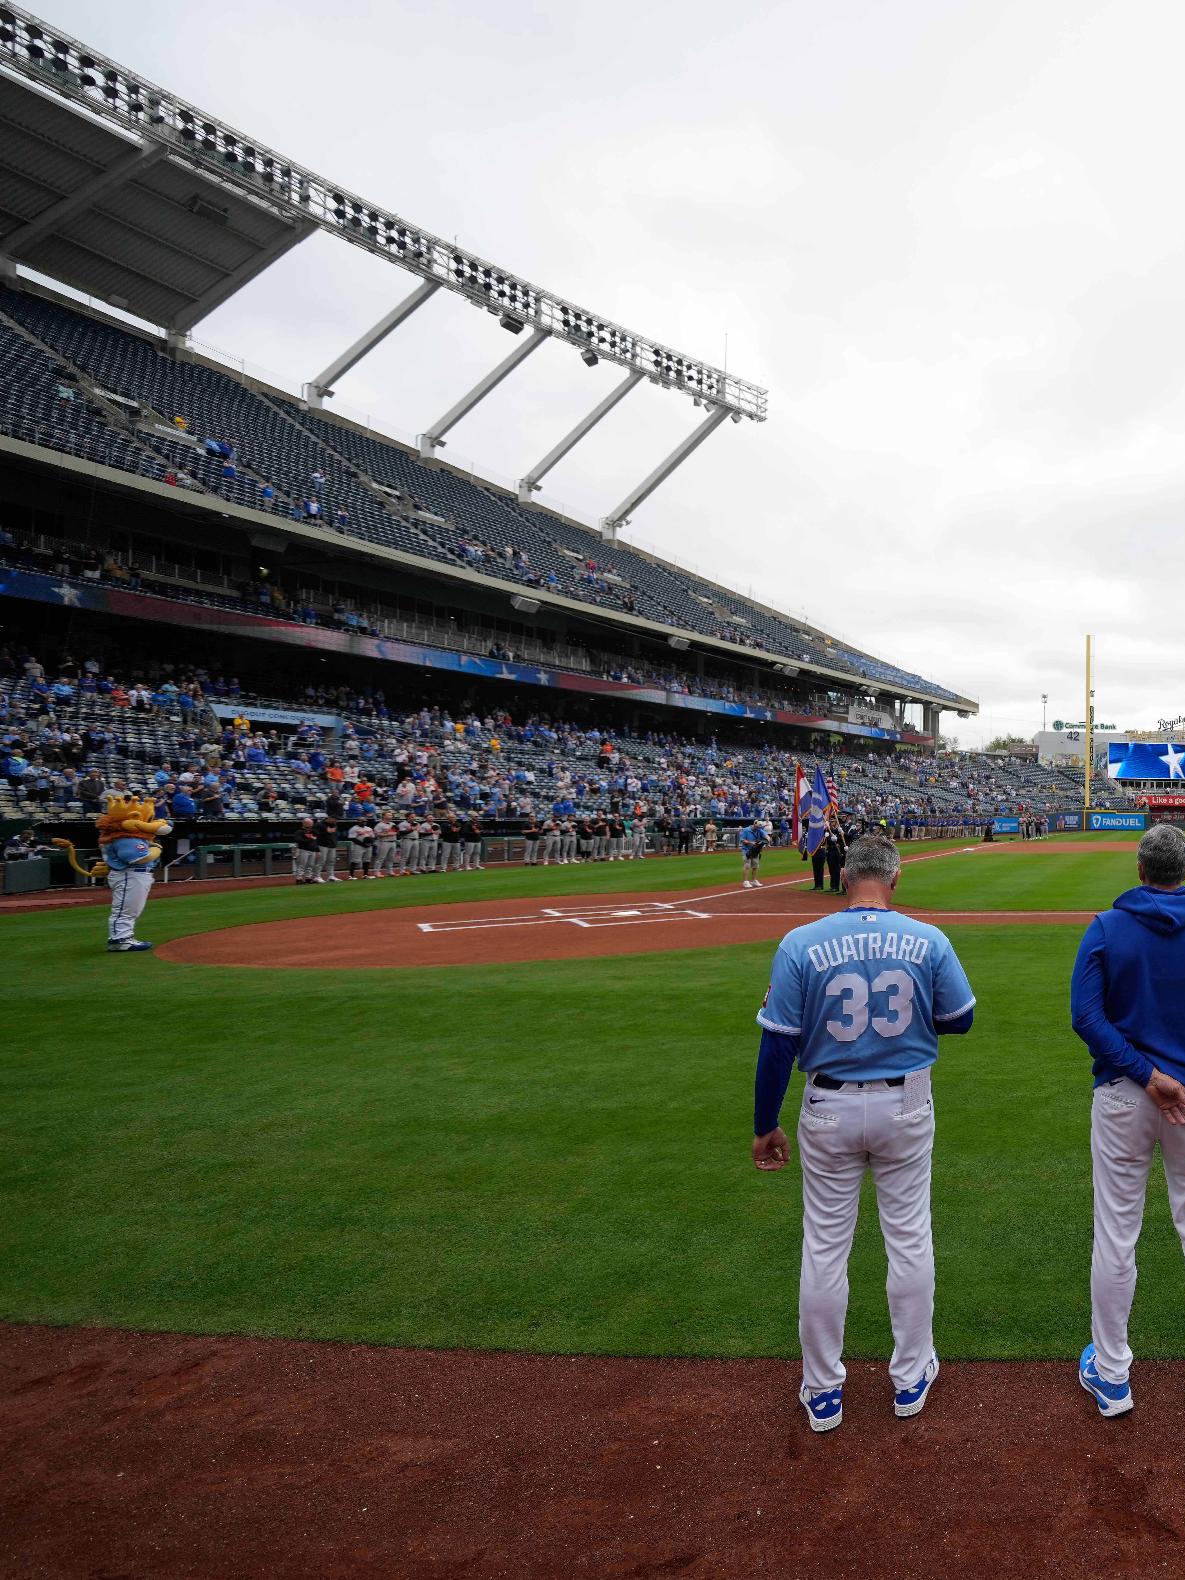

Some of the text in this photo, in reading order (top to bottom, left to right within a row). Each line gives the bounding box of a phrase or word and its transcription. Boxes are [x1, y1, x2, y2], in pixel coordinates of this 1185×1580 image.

[1158, 715, 1185, 731] Royals
[1066, 731, 1080, 742] 42
[1152, 796, 1167, 804] Like
[1102, 818, 1141, 826] FANDUEL
[807, 932, 929, 973] QUATRARO
[825, 969, 914, 1042] 33
